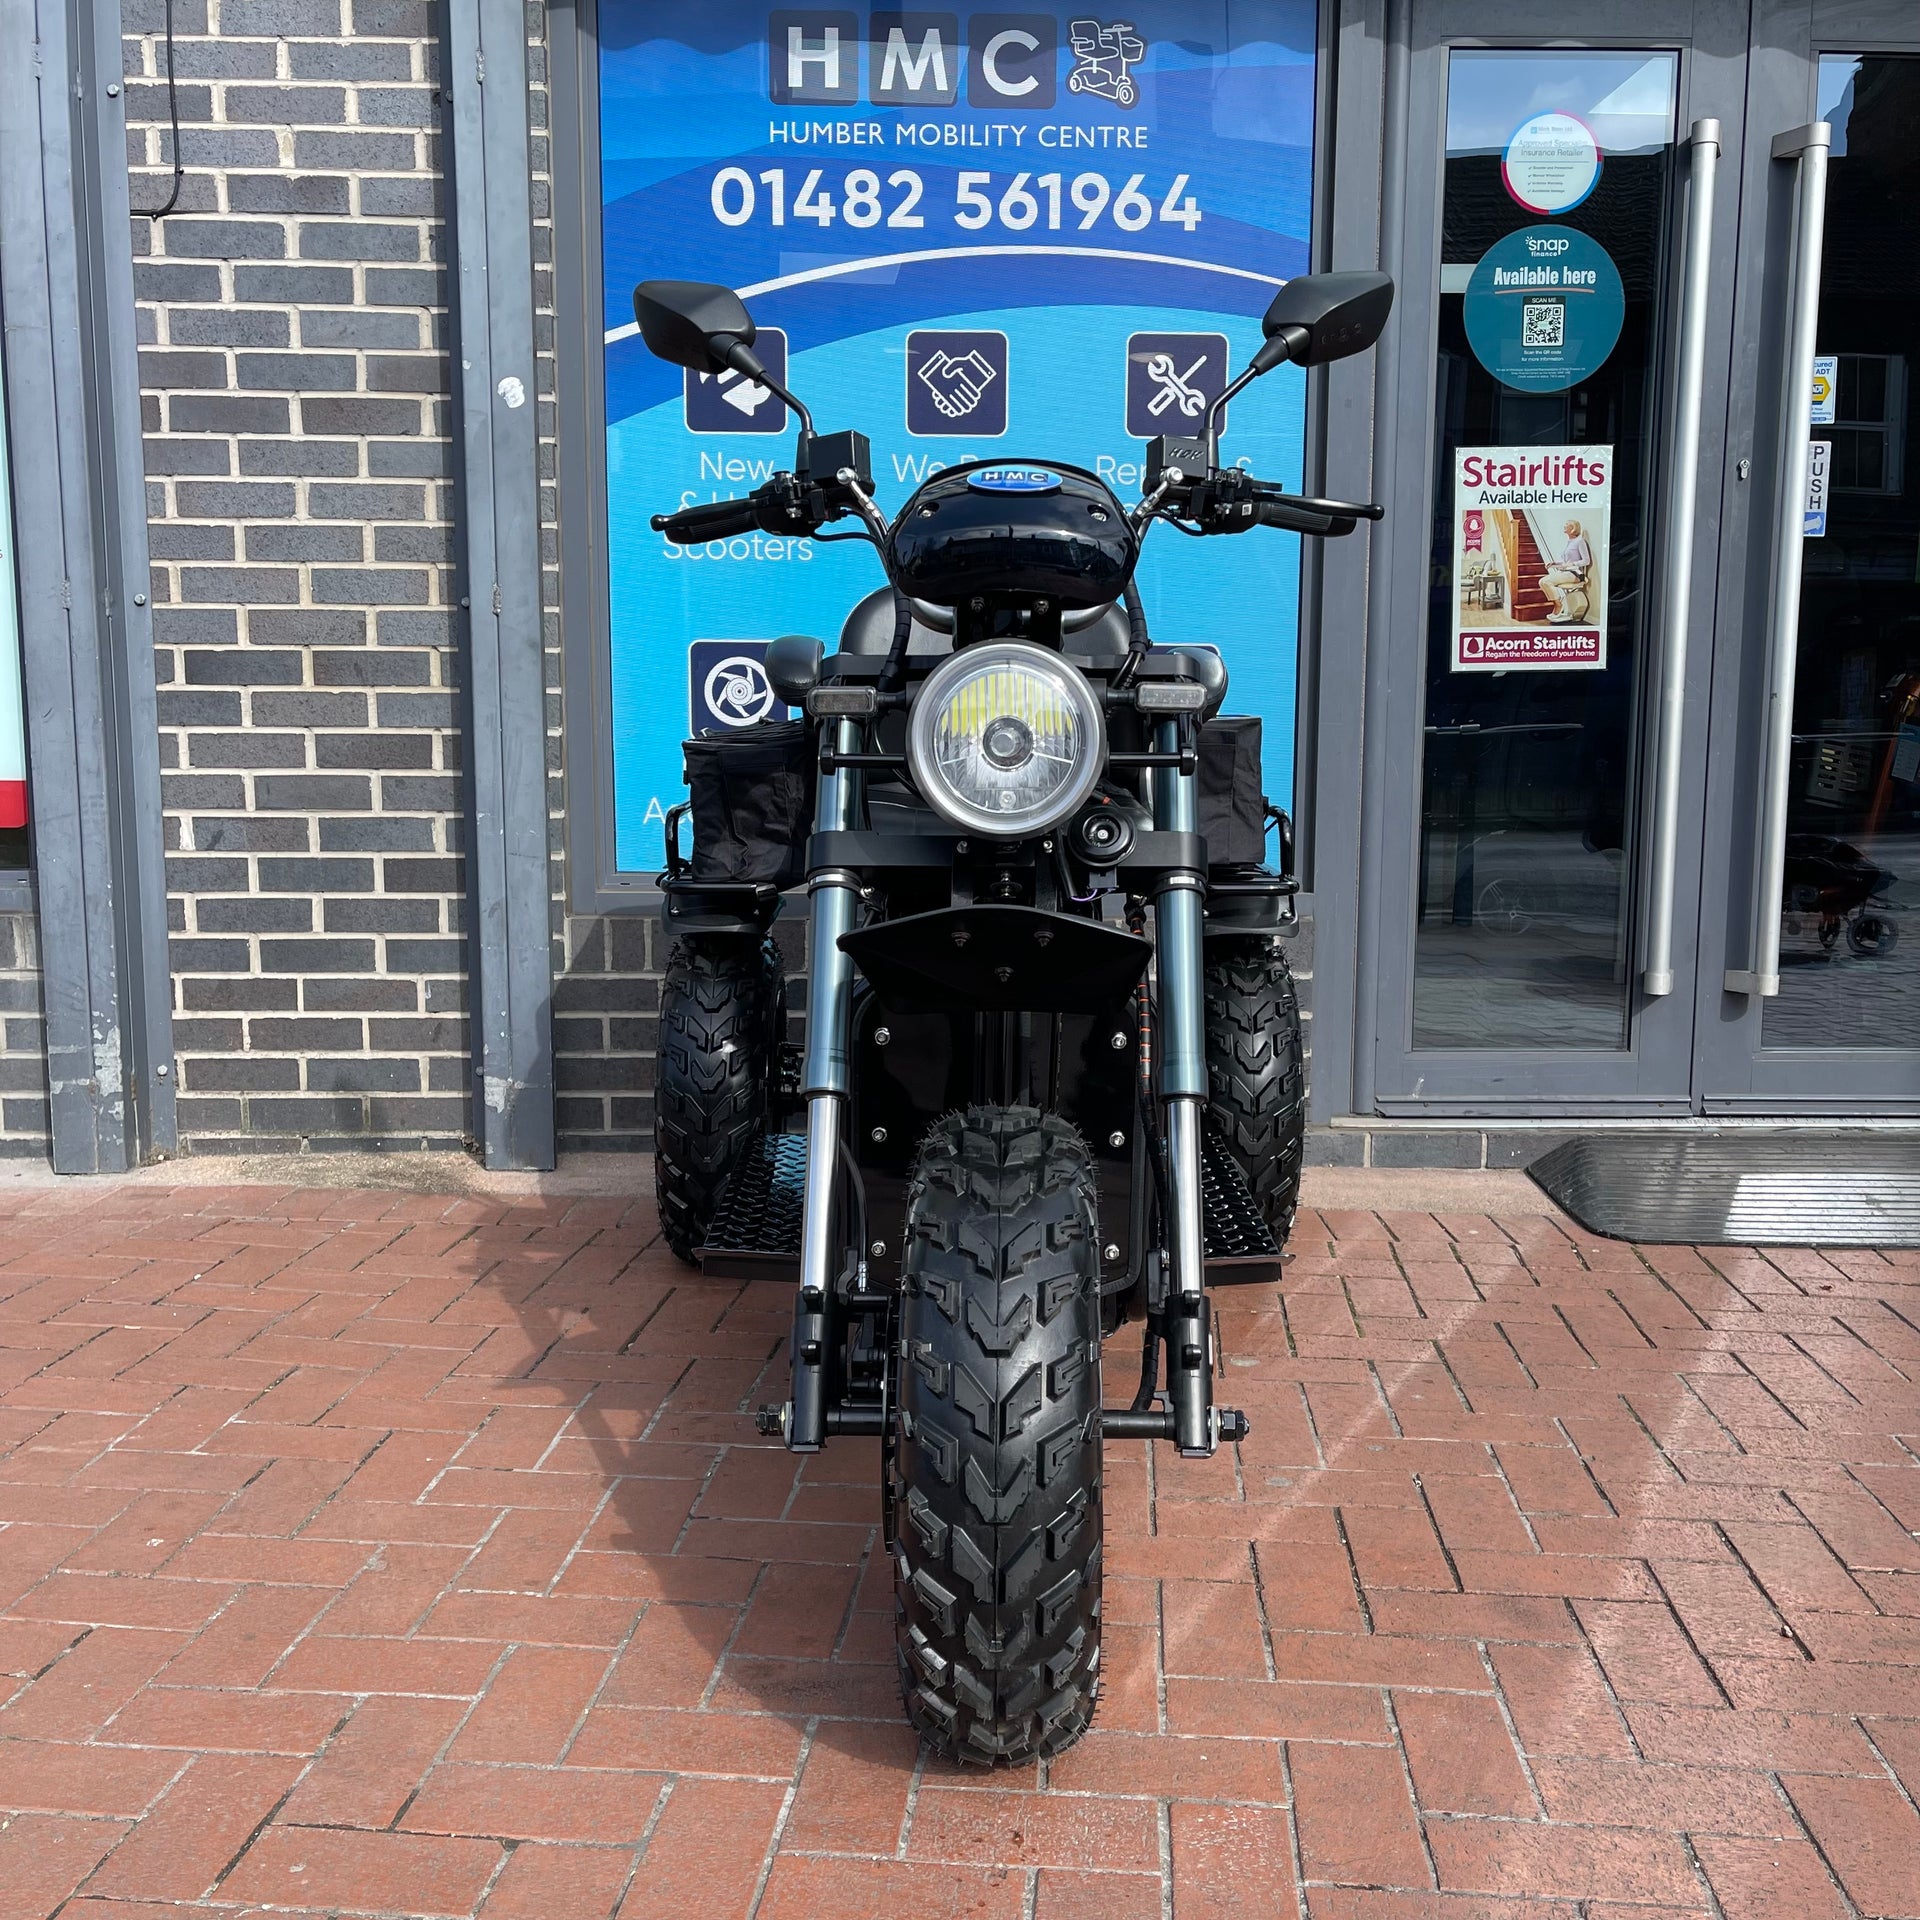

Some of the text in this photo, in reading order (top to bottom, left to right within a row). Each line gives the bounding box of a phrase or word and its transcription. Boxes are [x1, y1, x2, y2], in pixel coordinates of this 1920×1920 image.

[769, 120, 1148, 148] HUMBER MOBILITY CENTRE
[1521, 149, 1584, 157] Insurance Retailer
[711, 166, 1202, 232] 01482 561964
[1528, 238, 1569, 255] snap
[1493, 266, 1597, 286] Available here
[701, 451, 775, 481] New
[892, 454, 947, 483] We
[1463, 455, 1605, 487] Stairlifts
[985, 471, 1046, 482] HMC
[1809, 445, 1825, 510] PUSH
[1479, 490, 1588, 504] Available Here
[1485, 636, 1595, 650] Acorn Stairlifts
[1485, 651, 1509, 659] Regain
[1521, 650, 1550, 658] freedom
[1558, 651, 1574, 659] your
